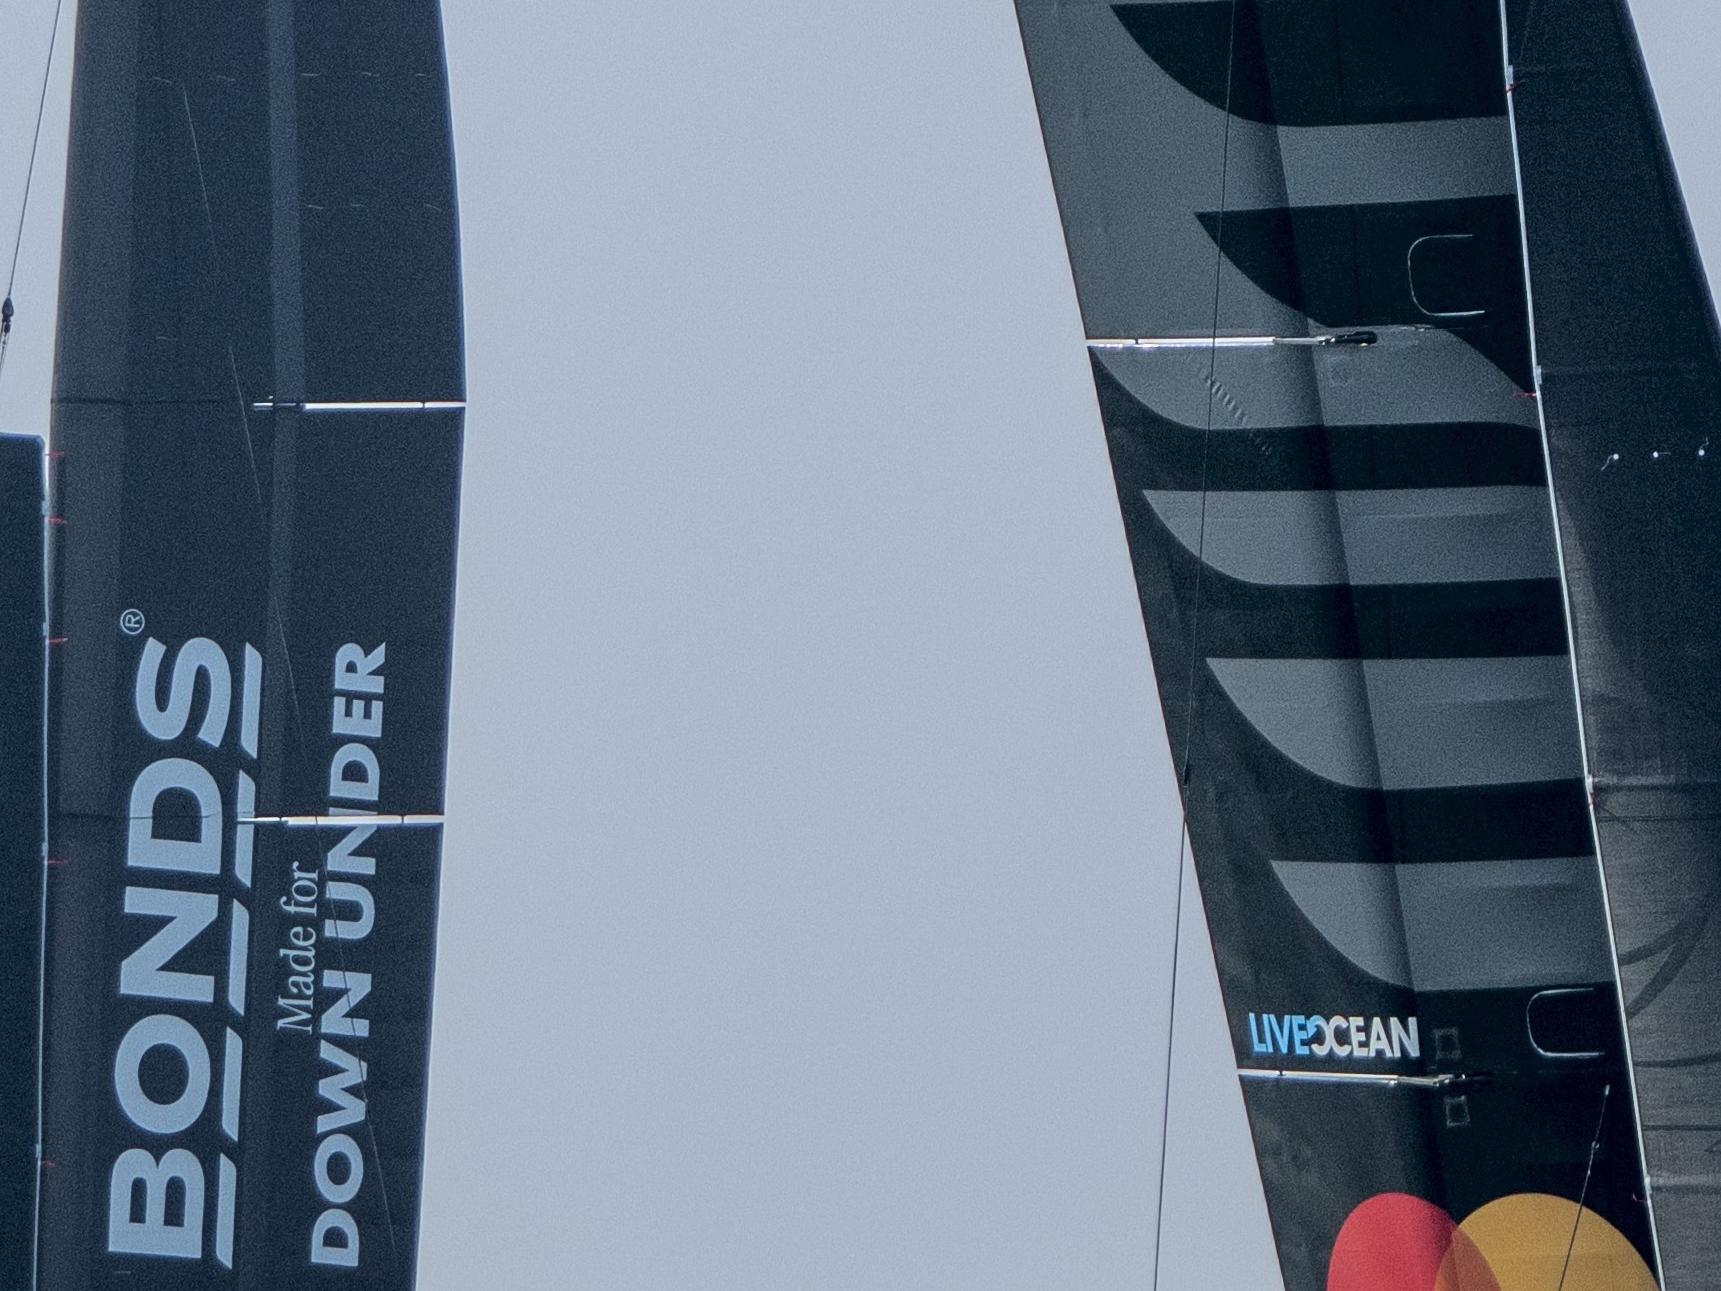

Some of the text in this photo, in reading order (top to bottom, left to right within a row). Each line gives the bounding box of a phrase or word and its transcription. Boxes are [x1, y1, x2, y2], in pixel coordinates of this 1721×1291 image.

[277, 861, 319, 1033] Made for
[310, 642, 386, 1267] DOWN UNDER
